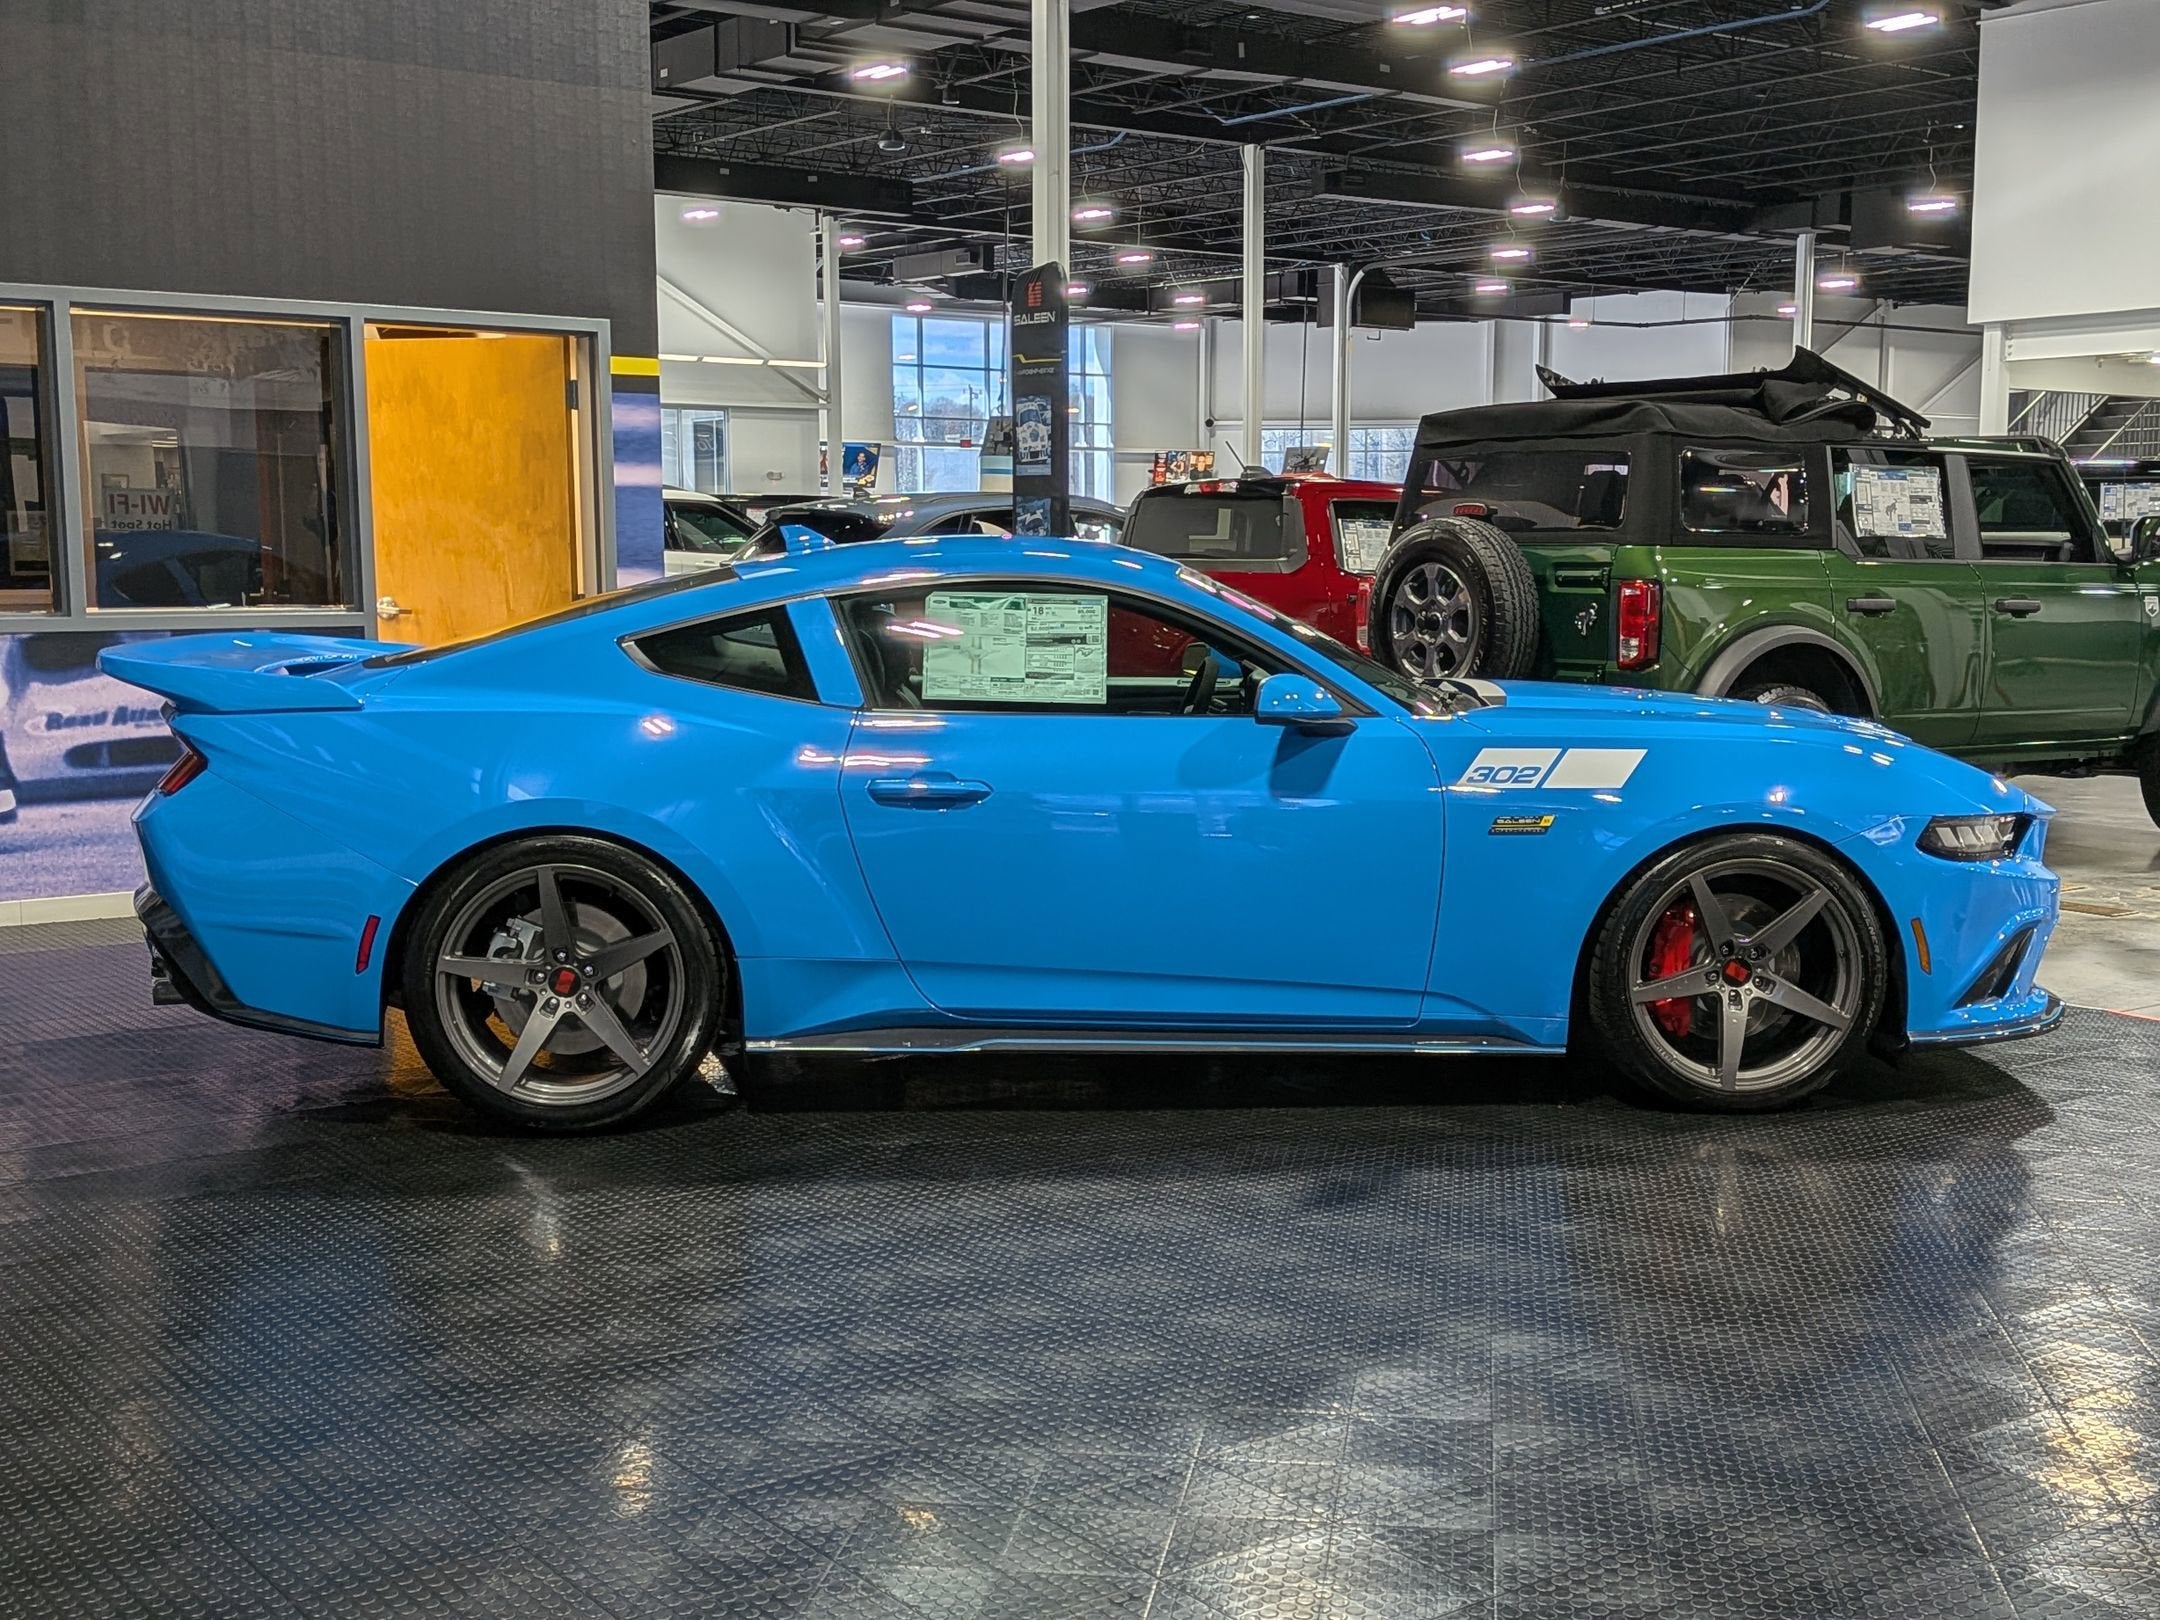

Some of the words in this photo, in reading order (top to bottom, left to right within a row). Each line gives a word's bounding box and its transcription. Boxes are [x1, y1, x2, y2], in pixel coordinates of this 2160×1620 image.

[1013, 311, 1056, 326] SALEEN
[1032, 606, 1044, 615] 18
[1466, 766, 1543, 784] 302
